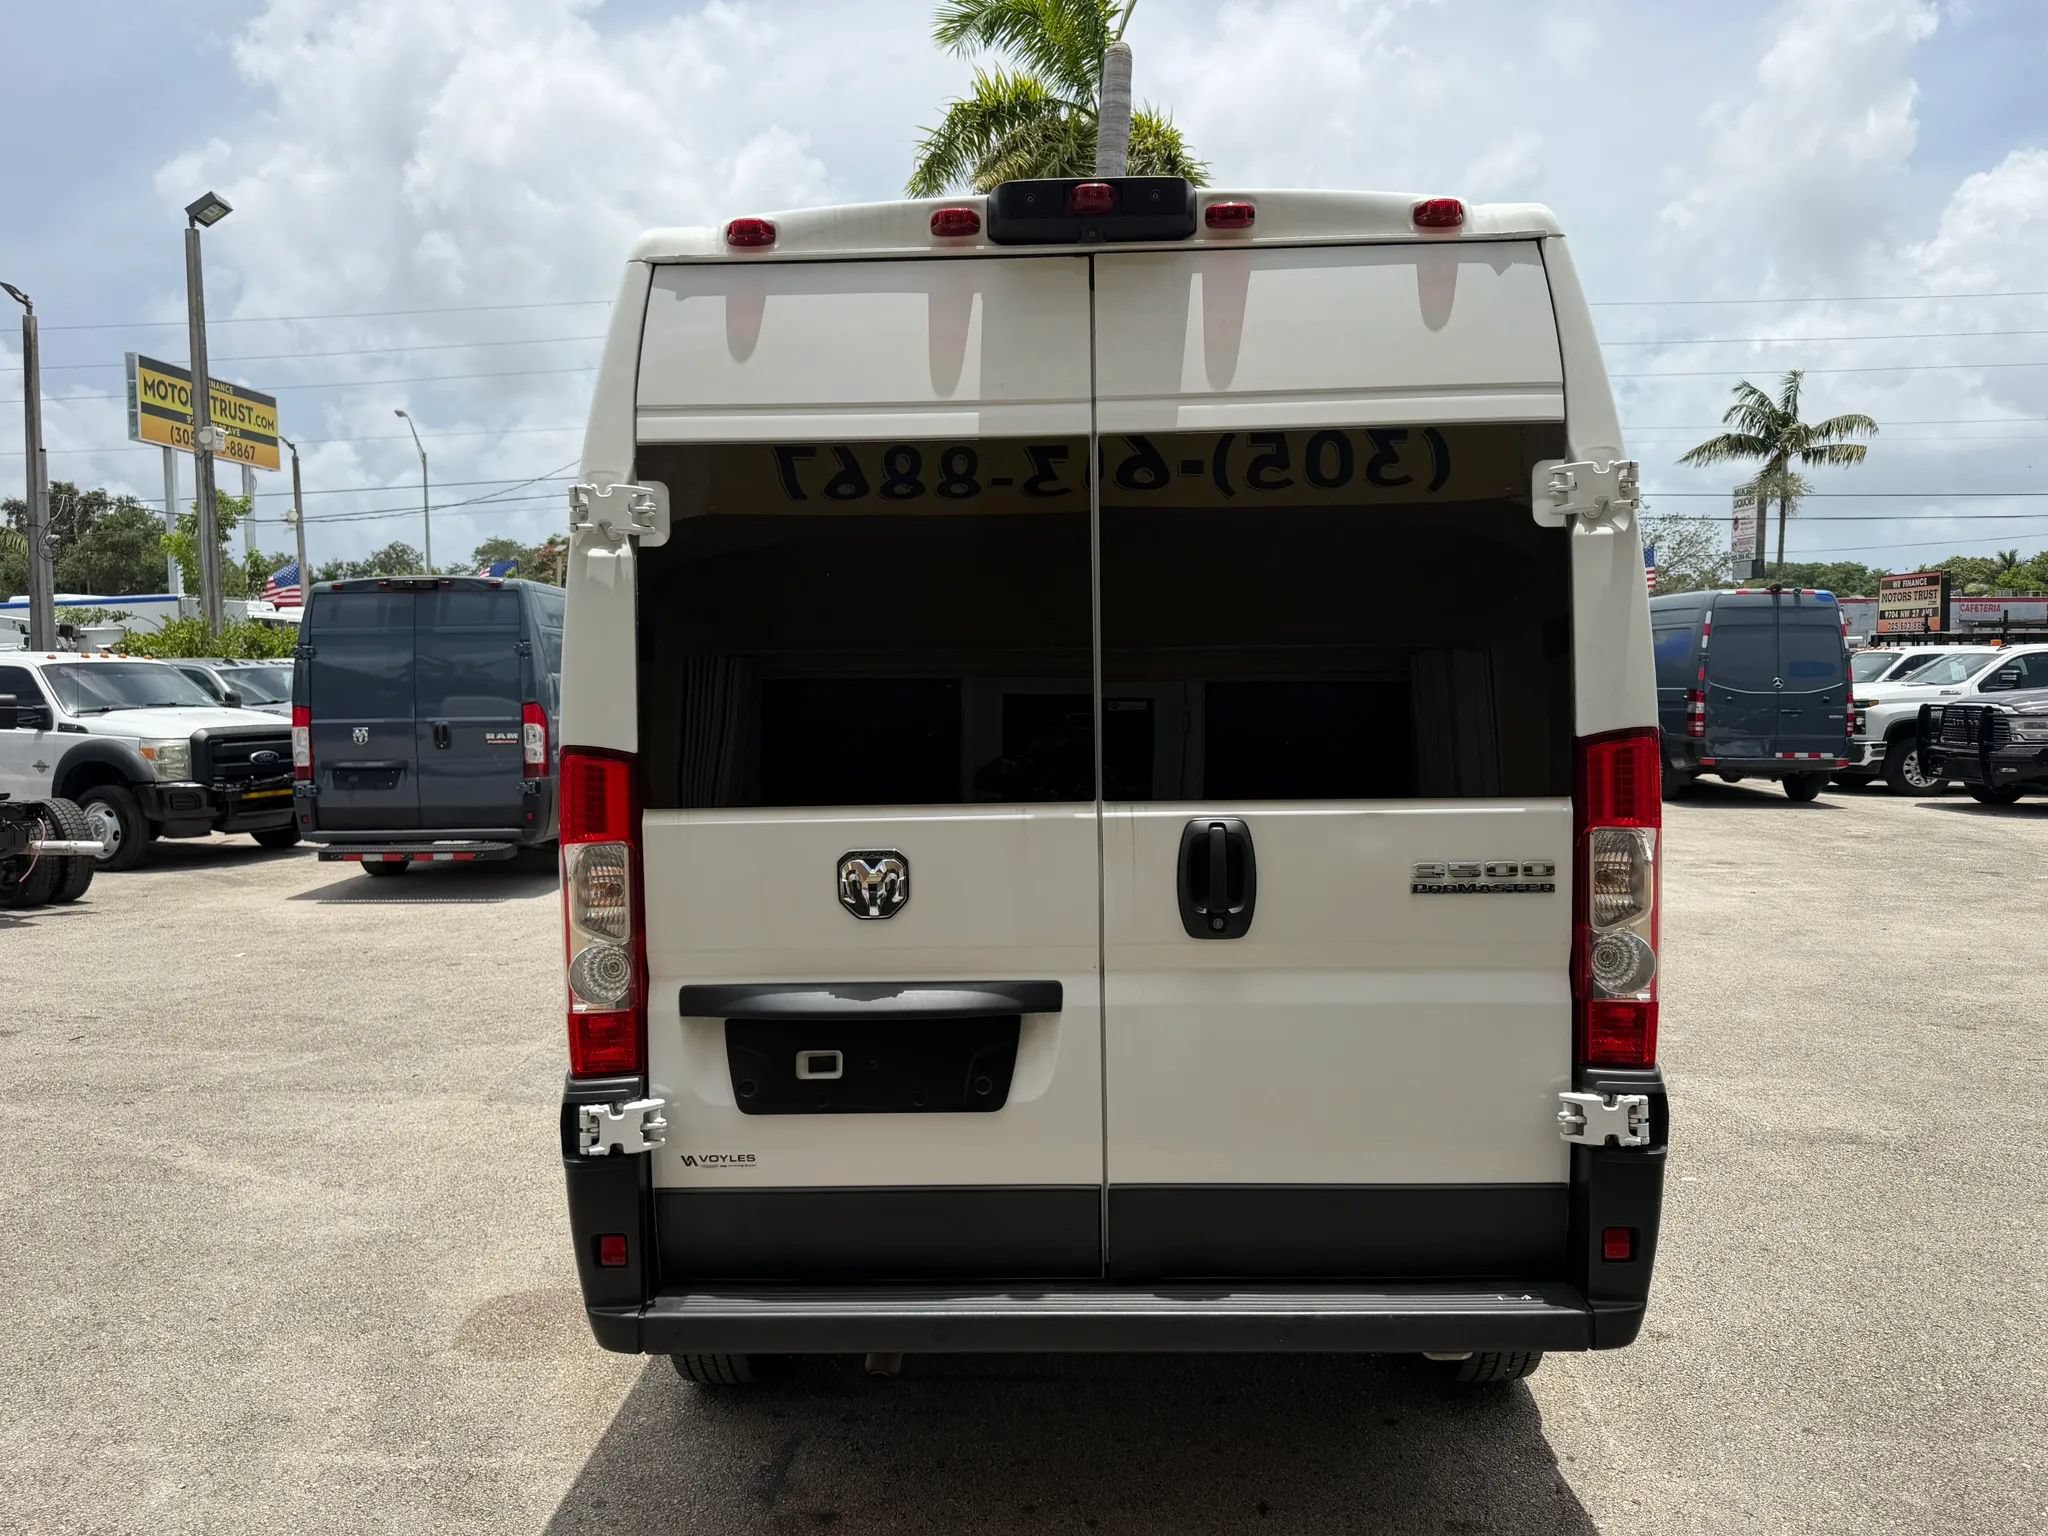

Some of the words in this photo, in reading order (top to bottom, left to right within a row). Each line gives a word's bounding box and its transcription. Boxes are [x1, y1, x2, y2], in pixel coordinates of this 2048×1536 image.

[208, 380, 233, 394] INANCE
[143, 374, 193, 409] MOTO
[210, 395, 275, 432] TRUST.COM
[1902, 578, 1927, 588] FINANCE
[1881, 591, 1912, 603] MOTORS
[1914, 589, 1938, 600] TRUST
[1960, 603, 2001, 613] CAFETERIA
[698, 1154, 756, 1163] VOYLES
